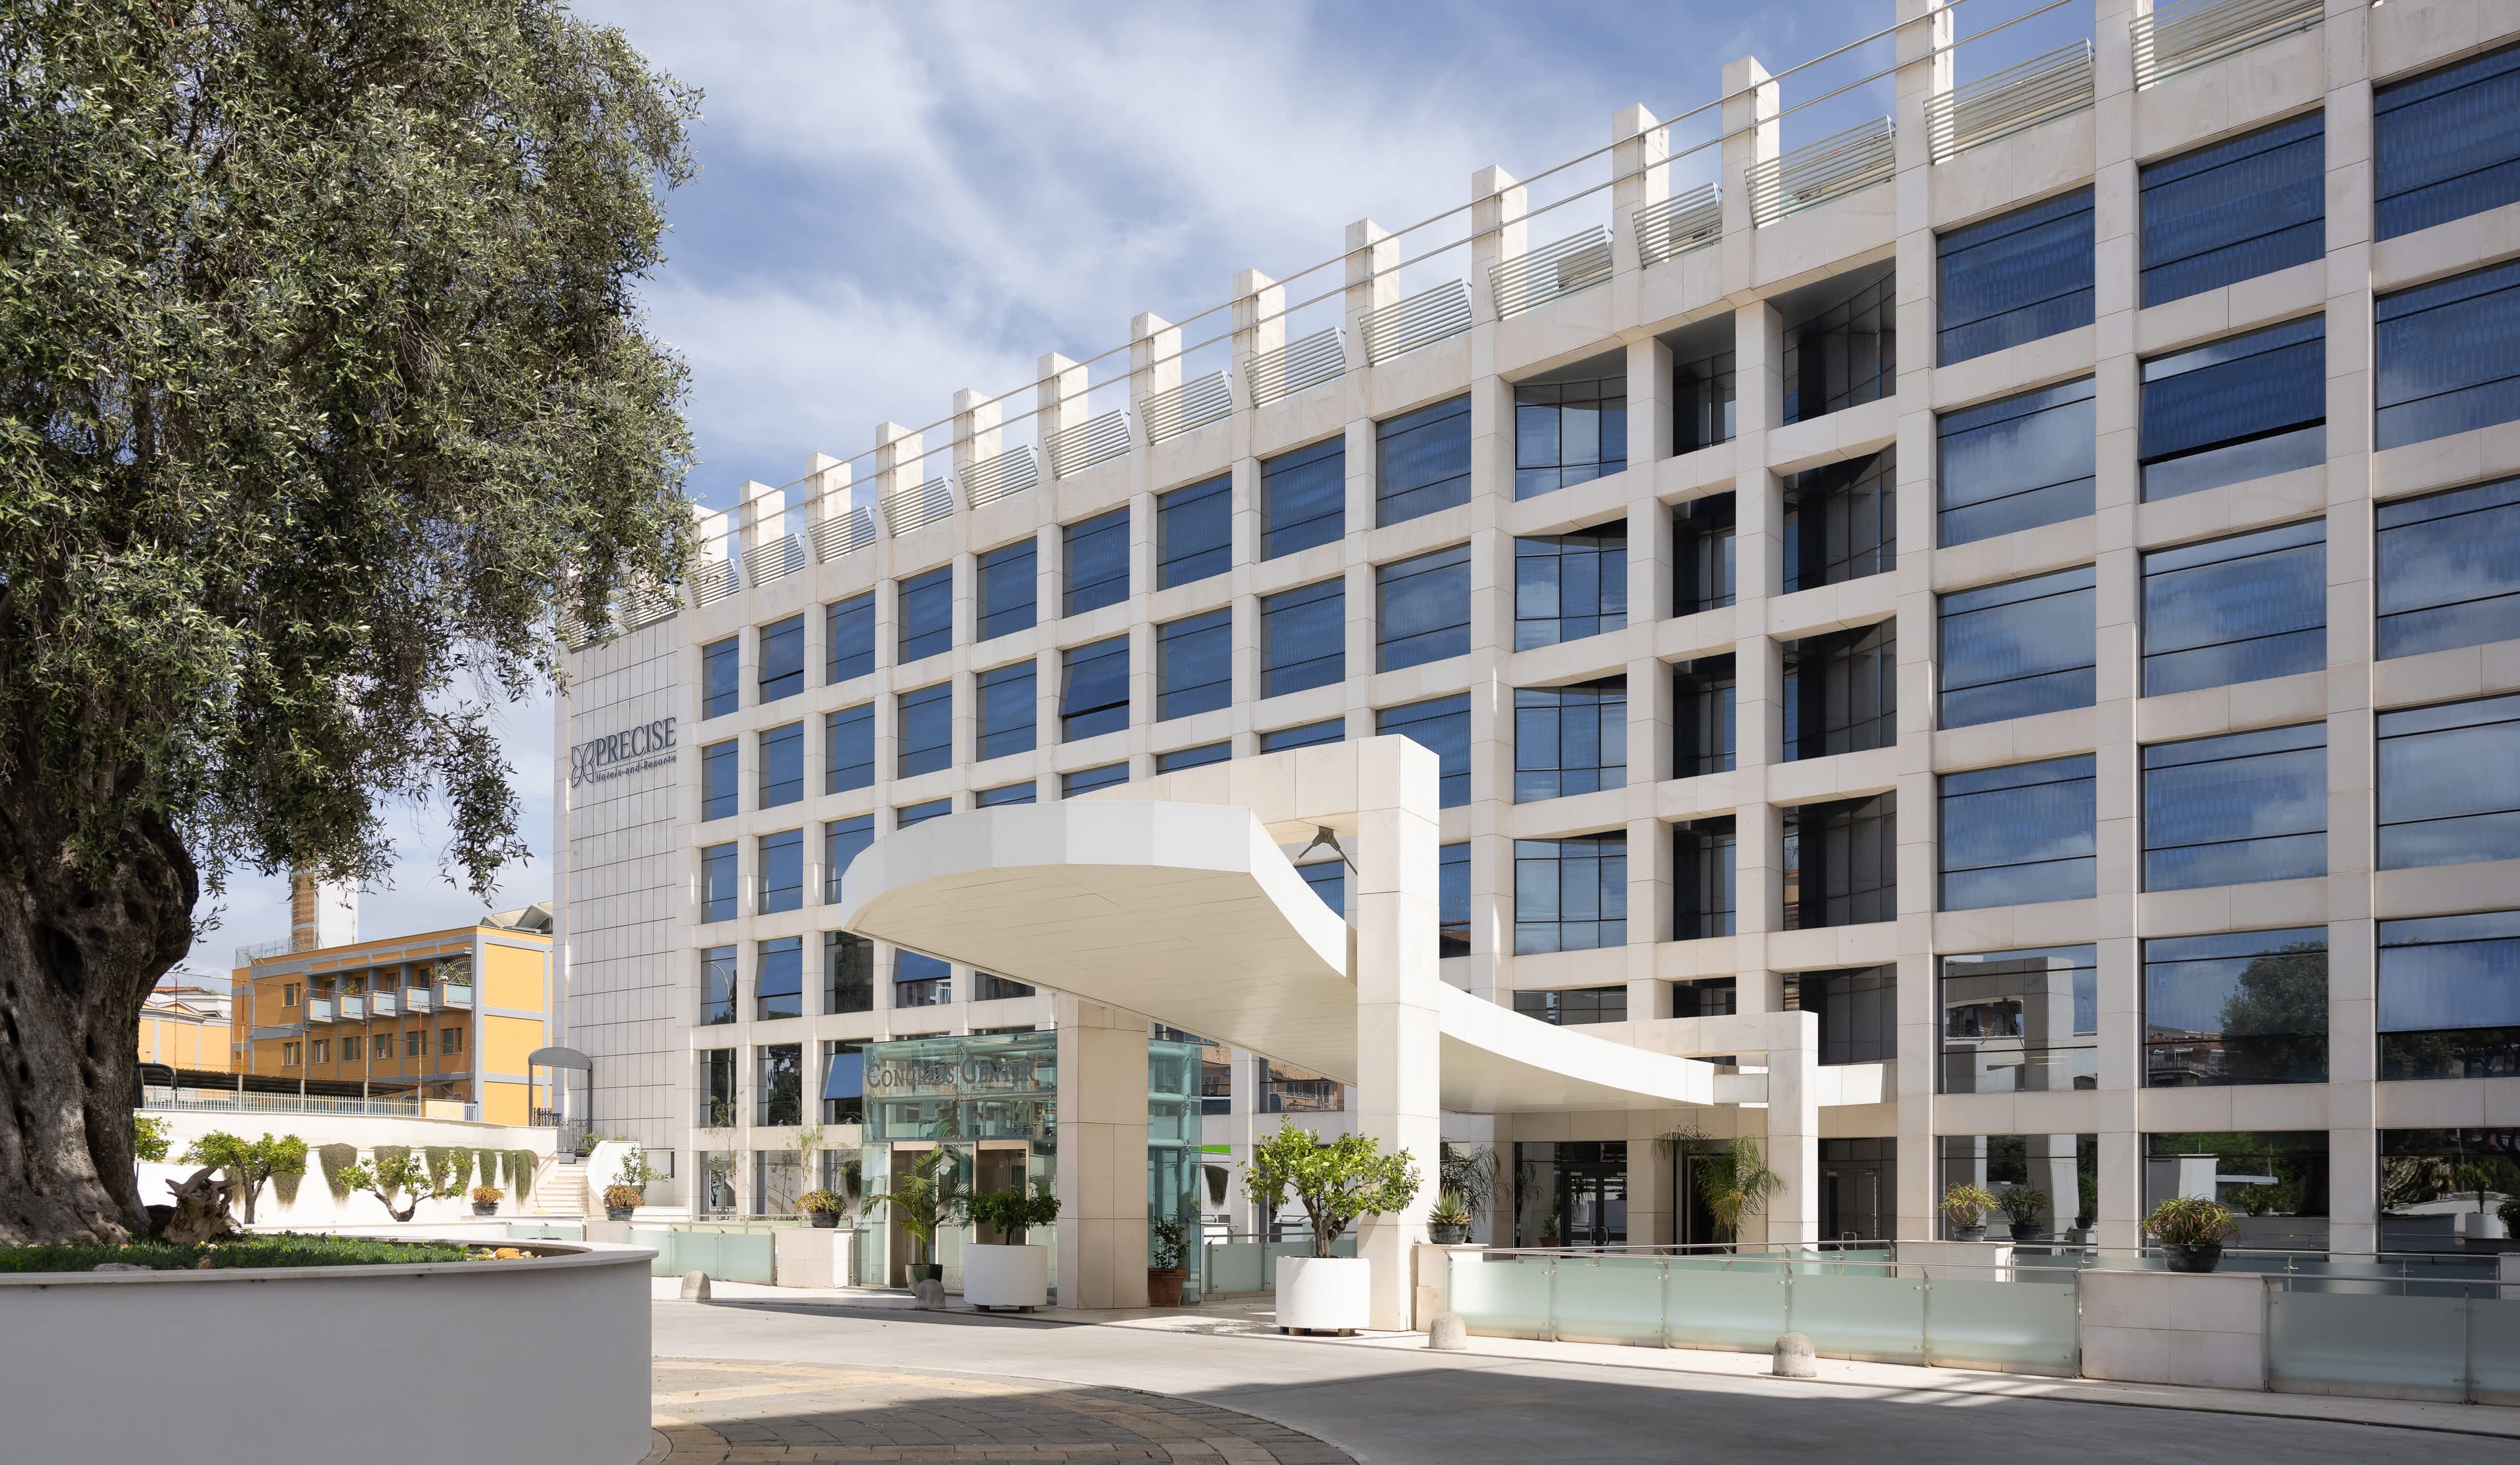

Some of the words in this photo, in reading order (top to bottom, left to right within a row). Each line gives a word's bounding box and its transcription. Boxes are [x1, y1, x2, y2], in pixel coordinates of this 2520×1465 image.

[594, 716, 677, 767] PRECISE
[596, 768, 622, 783] Hotels
[625, 764, 640, 775] and
[643, 755, 677, 770] Resorts
